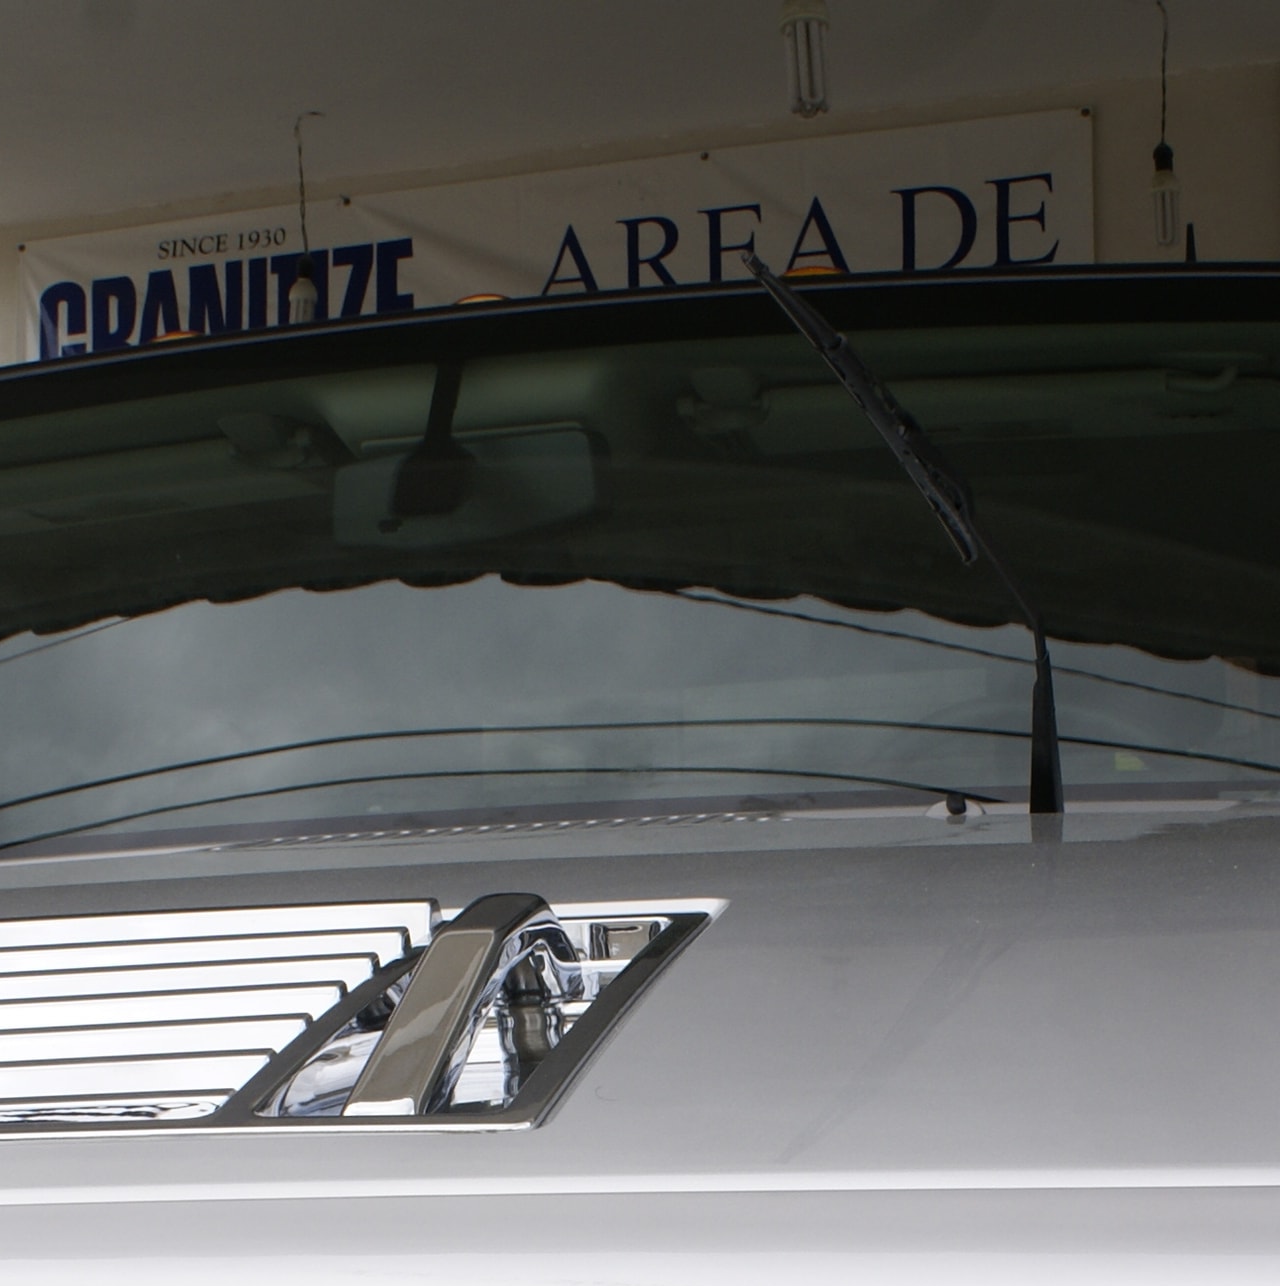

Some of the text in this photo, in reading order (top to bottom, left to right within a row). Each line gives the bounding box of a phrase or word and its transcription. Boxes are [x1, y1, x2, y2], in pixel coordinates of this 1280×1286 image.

[158, 227, 286, 259] SINCE 1930
[891, 173, 1059, 272] DE
